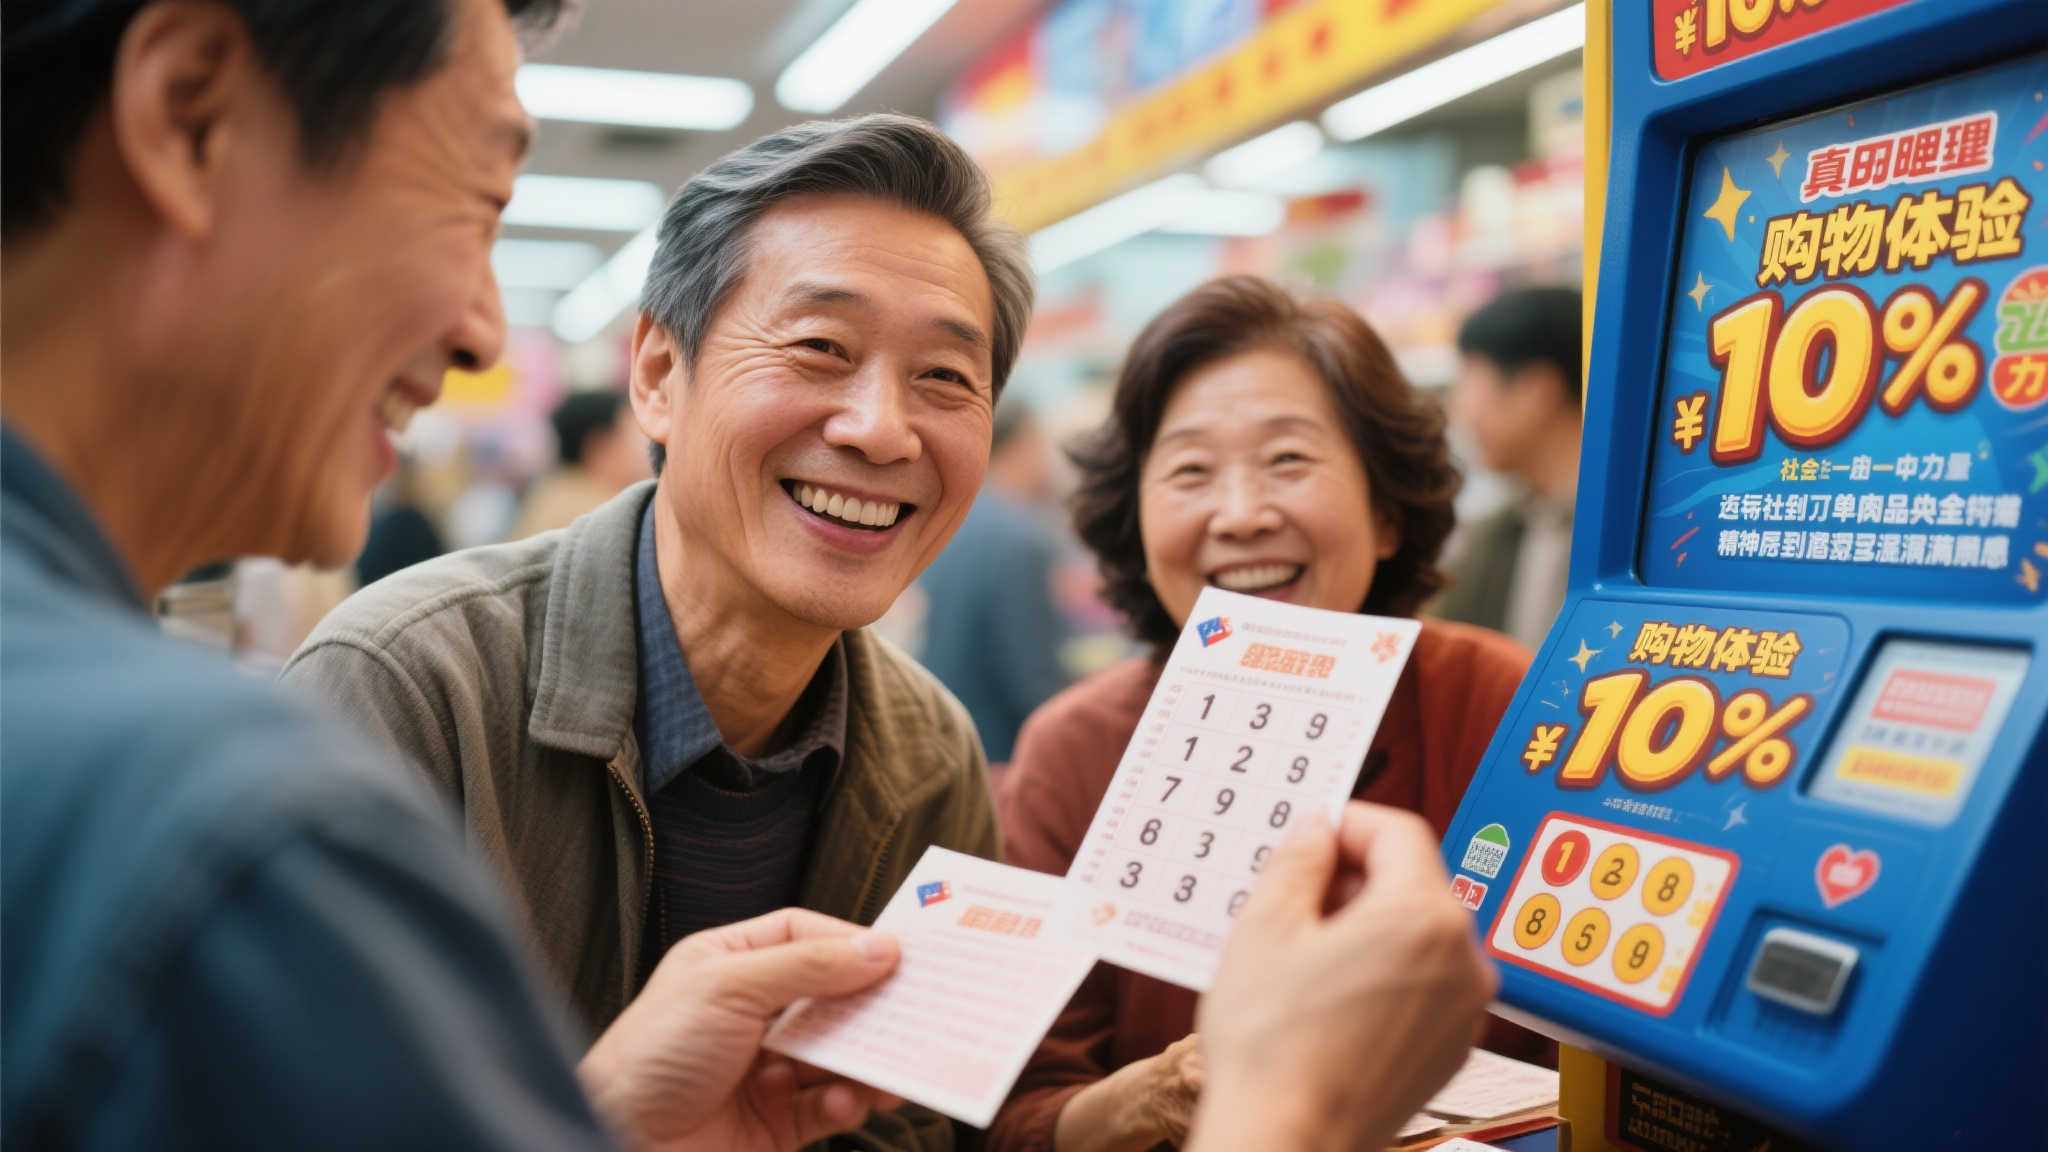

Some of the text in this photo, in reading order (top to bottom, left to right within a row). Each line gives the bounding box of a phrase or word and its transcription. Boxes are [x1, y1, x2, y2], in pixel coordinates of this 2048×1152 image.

[1757, 179, 2028, 284] 购物体验
[1629, 621, 1801, 677] 购物体验
[1200, 693, 1329, 741] 1 3 9
[1183, 735, 1199, 762] 1
[1229, 745, 1254, 774] 2
[1160, 775, 1292, 829] 7 9 8
[1194, 831, 1216, 859] 3
[1119, 860, 1144, 889] 3
[1172, 874, 1198, 904] 3
[1555, 841, 1575, 873] 1
[1657, 872, 1680, 902] 8
[1525, 908, 1546, 936] 8
